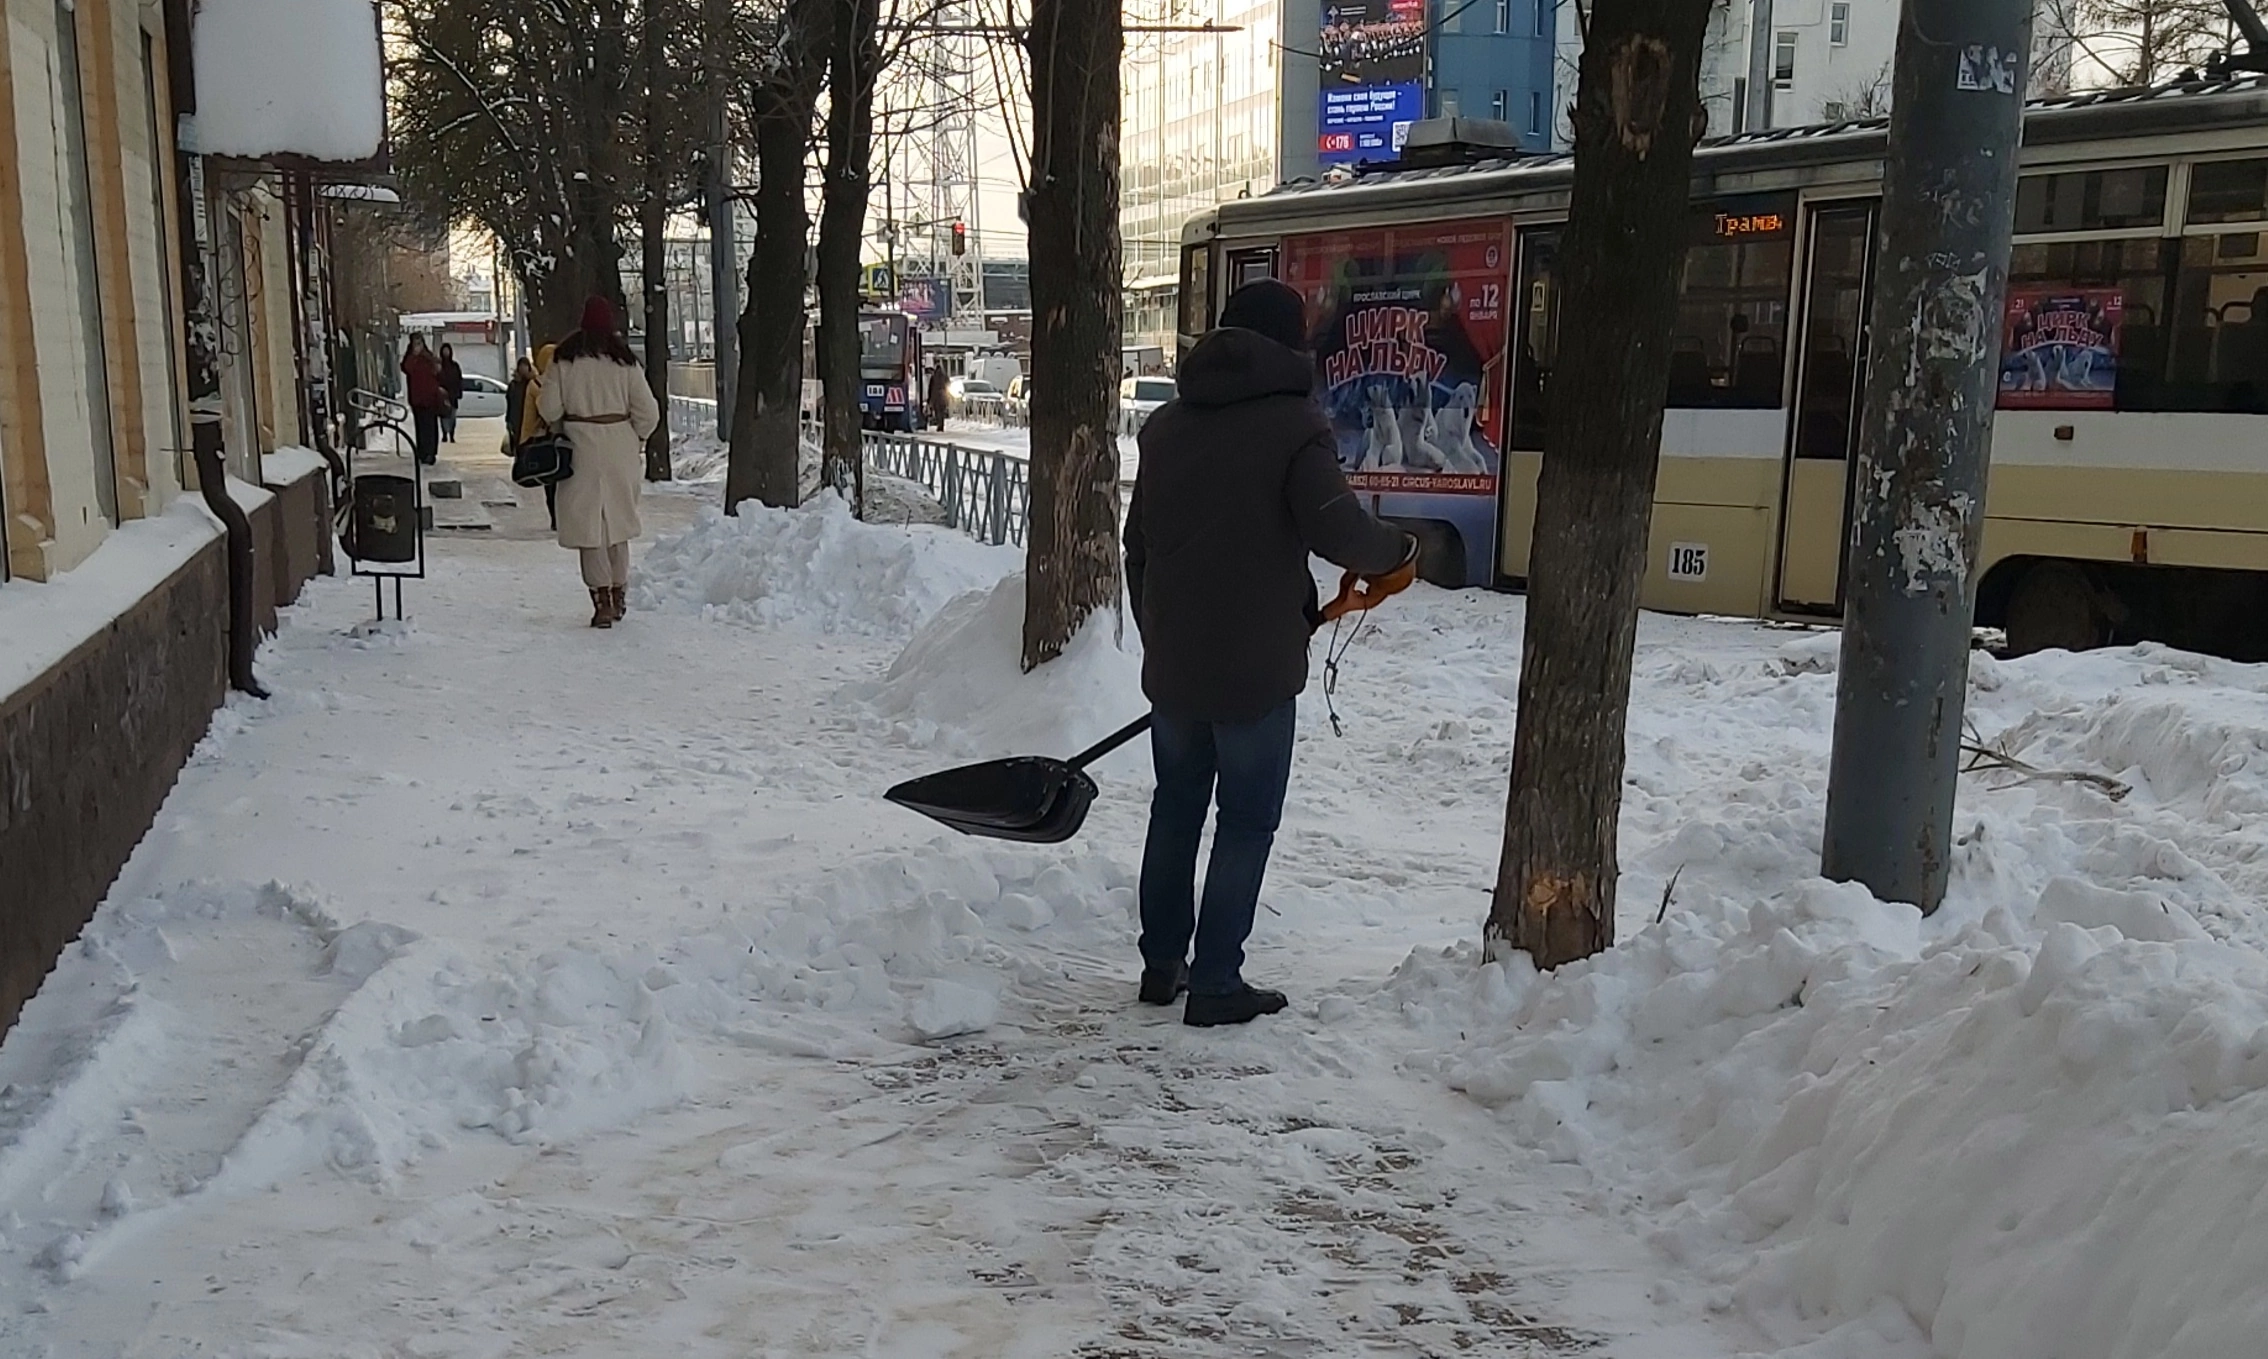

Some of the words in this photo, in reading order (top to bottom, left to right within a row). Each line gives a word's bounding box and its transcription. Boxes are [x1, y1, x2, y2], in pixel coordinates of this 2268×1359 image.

[1481, 283, 1499, 308] 12
[1346, 306, 1429, 350] ЦИРК
[2037, 310, 2091, 331] ЦИРК
[2021, 328, 2047, 349] НА
[2053, 325, 2104, 348] ЛЬДУ
[1326, 345, 1364, 391] НА
[1368, 340, 1448, 384] ЛЬДУ
[1672, 547, 1706, 576] 185
